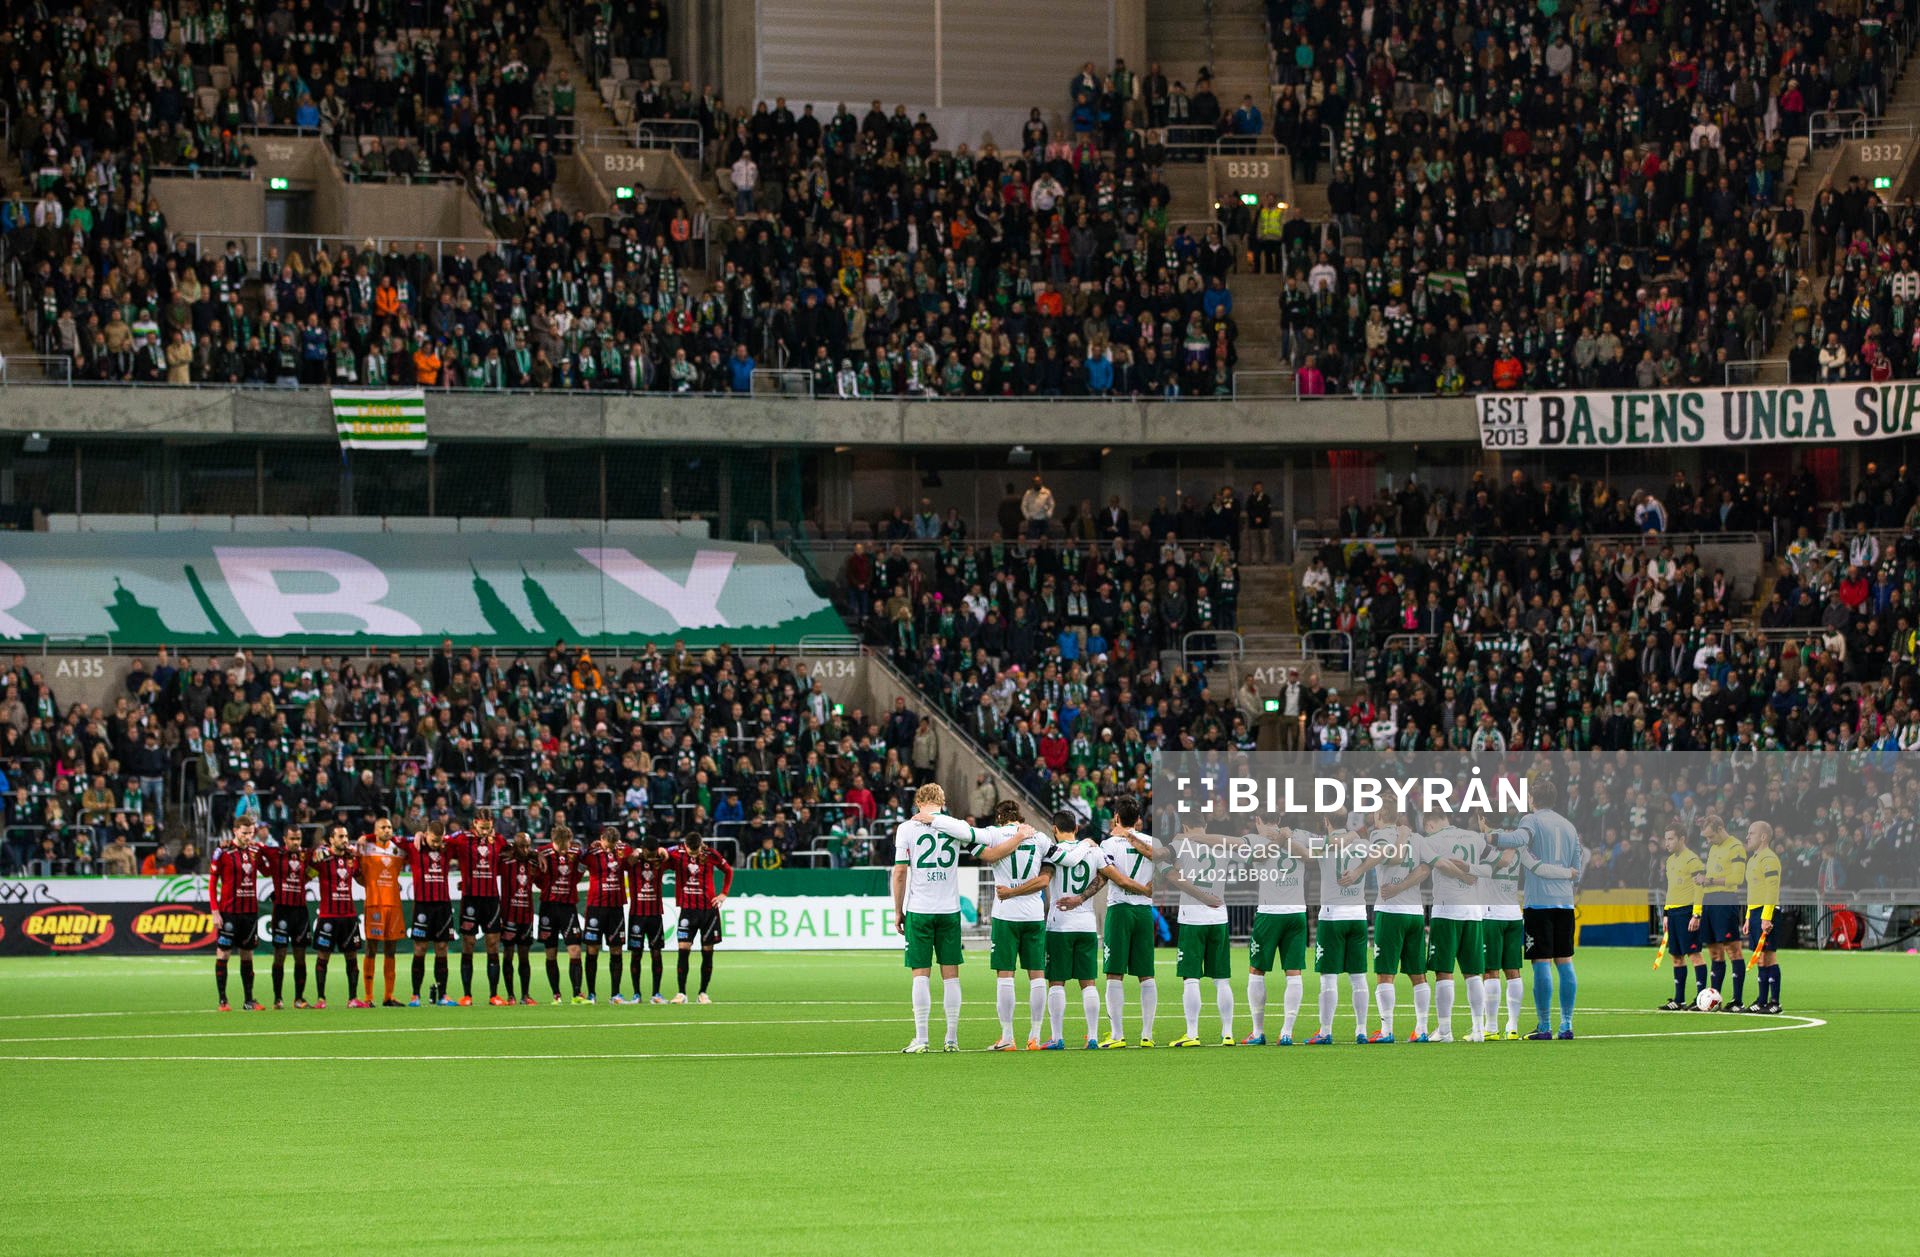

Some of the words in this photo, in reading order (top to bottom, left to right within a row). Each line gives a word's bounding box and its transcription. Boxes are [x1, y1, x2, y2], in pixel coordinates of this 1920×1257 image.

[604, 154, 645, 171] B334
[1861, 144, 1903, 162] B332
[1228, 161, 1269, 178] B333
[1482, 397, 1528, 425] EST
[1539, 392, 1705, 445] BAJENS
[1721, 388, 1836, 441] UNGA
[1853, 385, 1920, 437] SUP
[1484, 429, 1528, 446] 2013
[55, 658, 104, 678] A135
[811, 660, 856, 678] A134
[1254, 666, 1297, 684] A13
[916, 832, 956, 869] 23
[1011, 845, 1036, 880] 17
[1126, 848, 1144, 880] 7
[1193, 853, 1216, 888] 2
[1062, 860, 1091, 895] 19
[27, 914, 113, 935] BANDIT
[136, 914, 215, 934] BANDIT
[721, 908, 898, 938] ERBALIFE
